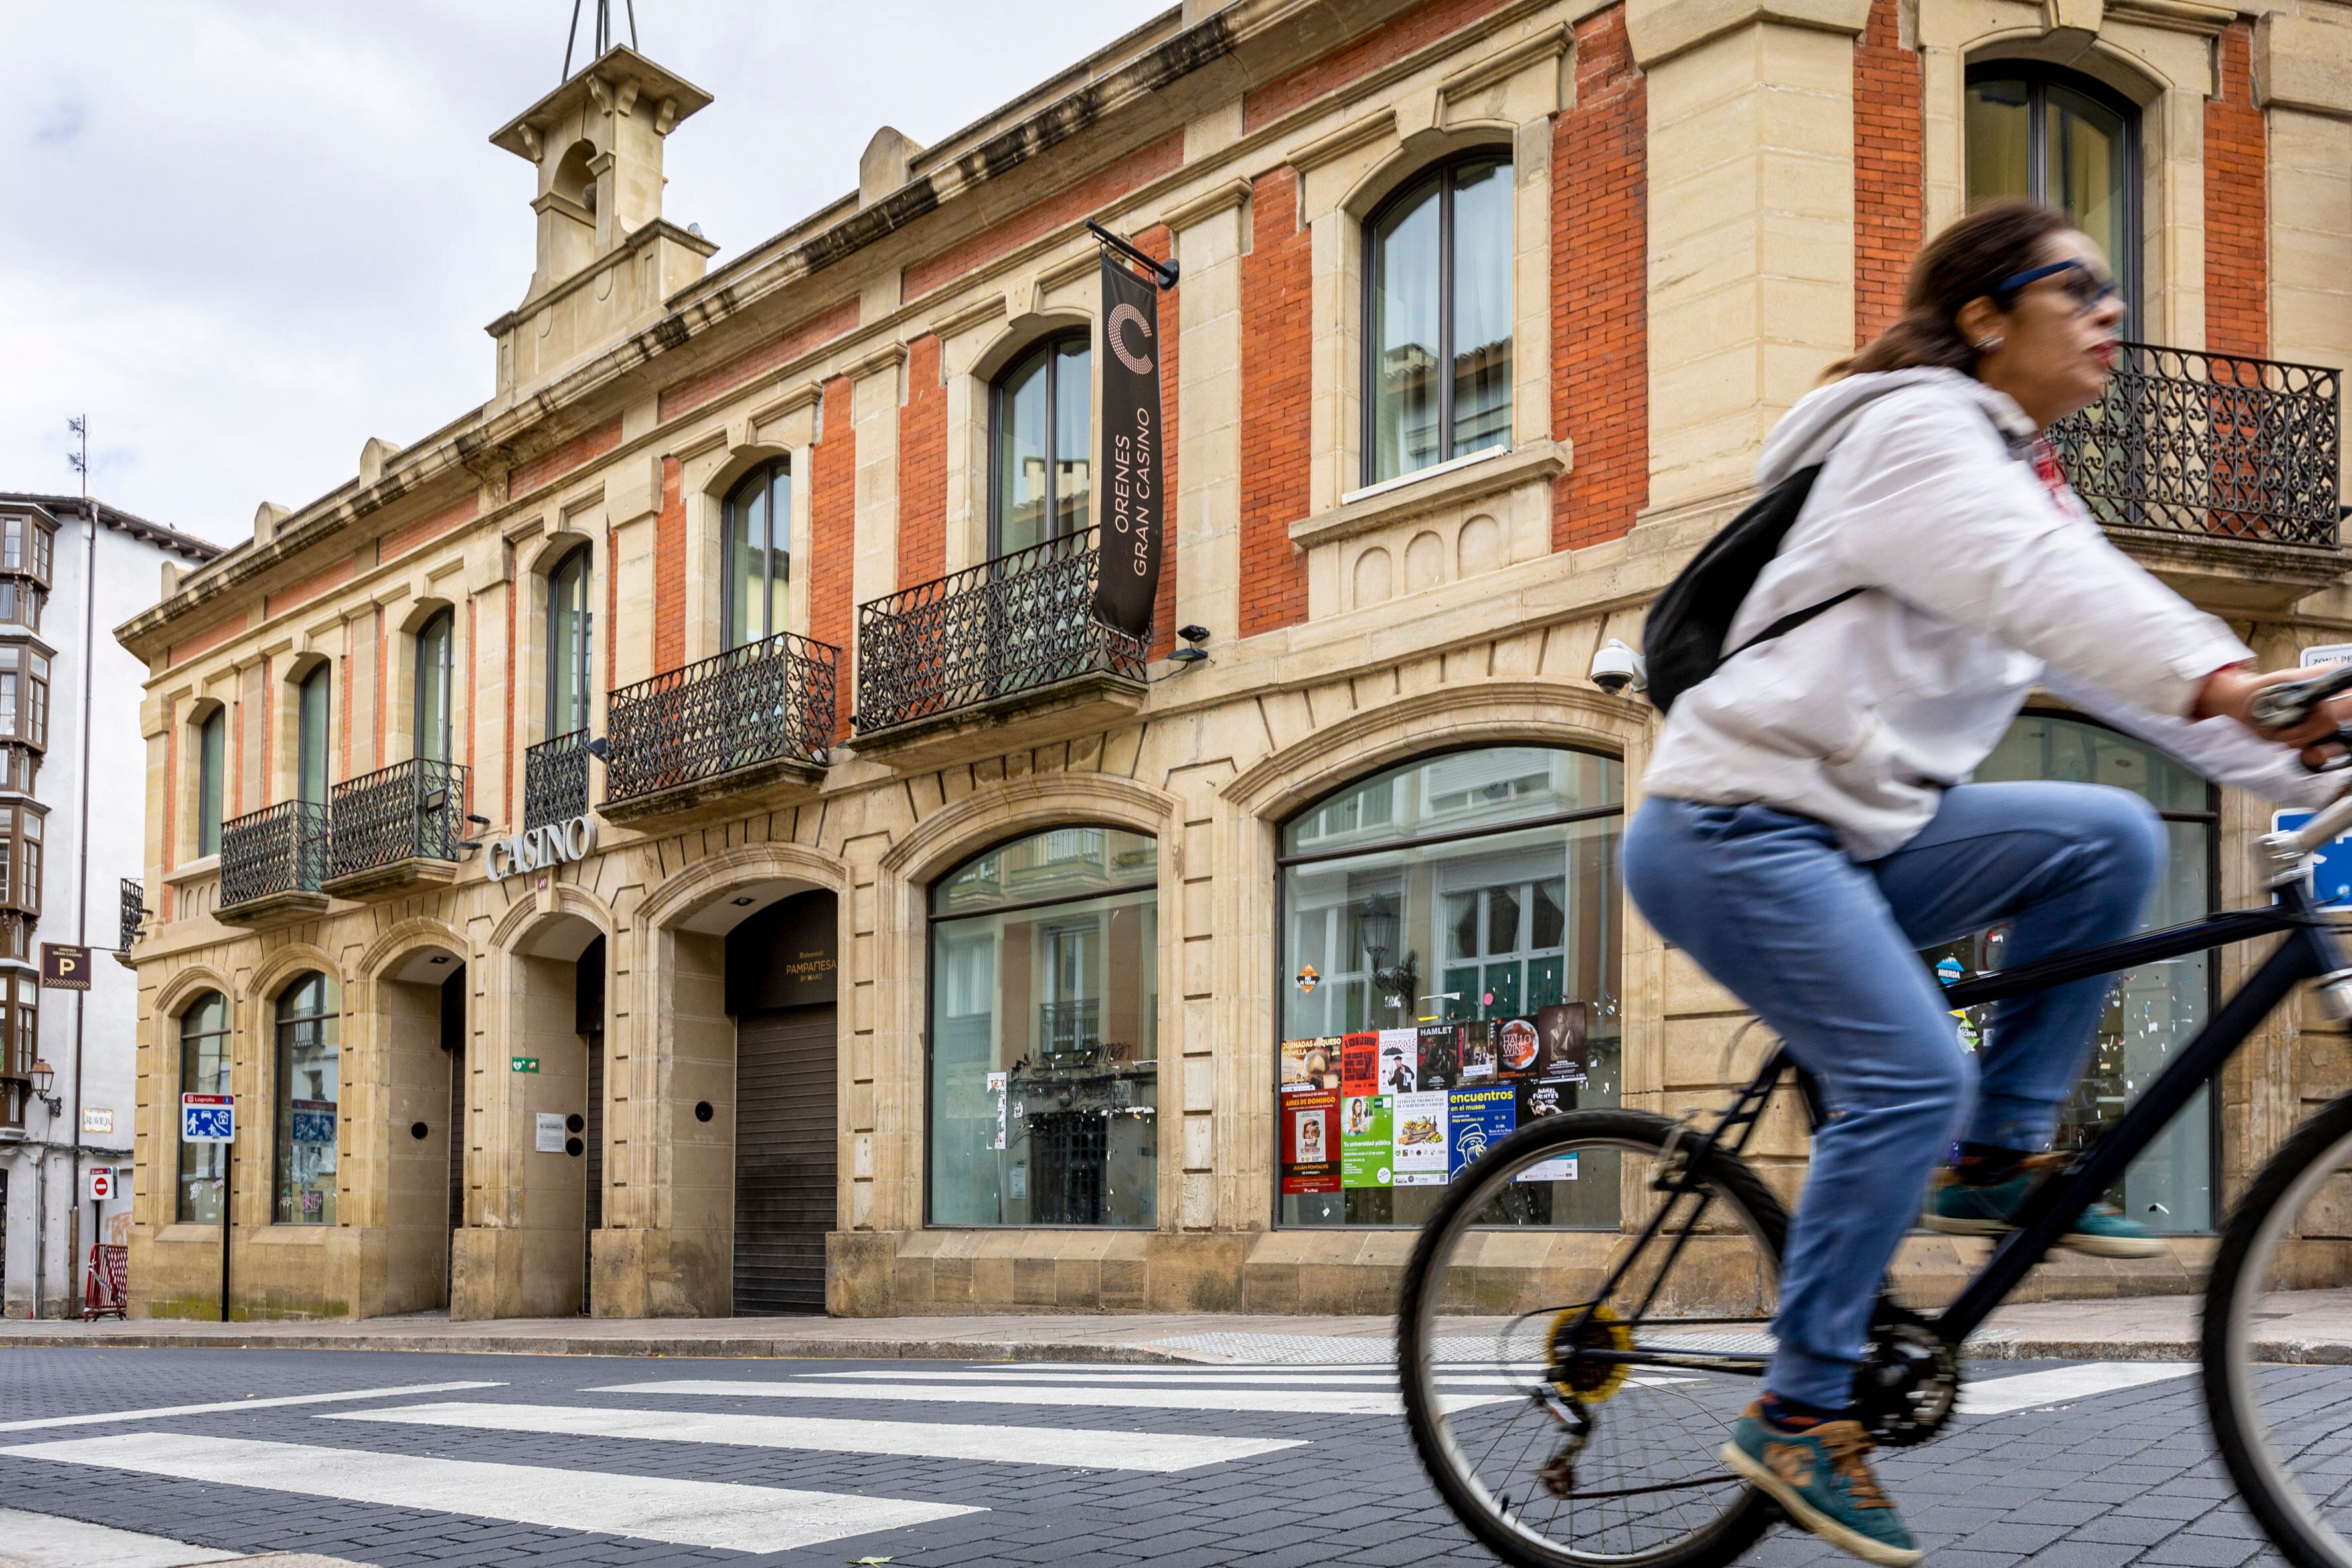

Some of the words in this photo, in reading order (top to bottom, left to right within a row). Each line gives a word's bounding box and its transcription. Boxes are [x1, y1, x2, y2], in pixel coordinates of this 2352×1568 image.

[1135, 406, 1150, 499] CASINO
[1115, 434, 1131, 535] ORENES
[1134, 505, 1149, 577] GRAN
[485, 816, 597, 882] CASINO
[538, 878, 547, 889] 10
[60, 958, 75, 976] P
[1938, 969, 1960, 980] MIERDA
[1420, 1026, 1453, 1036] HAMLET
[1282, 1040, 1313, 1050] JORNADAS
[1321, 1037, 1341, 1048] QUESO
[1503, 1034, 1531, 1046] HALLO
[1503, 1044, 1527, 1055] WINE
[1450, 1090, 1514, 1103] encuentros
[1375, 1138, 1391, 1147] pública
